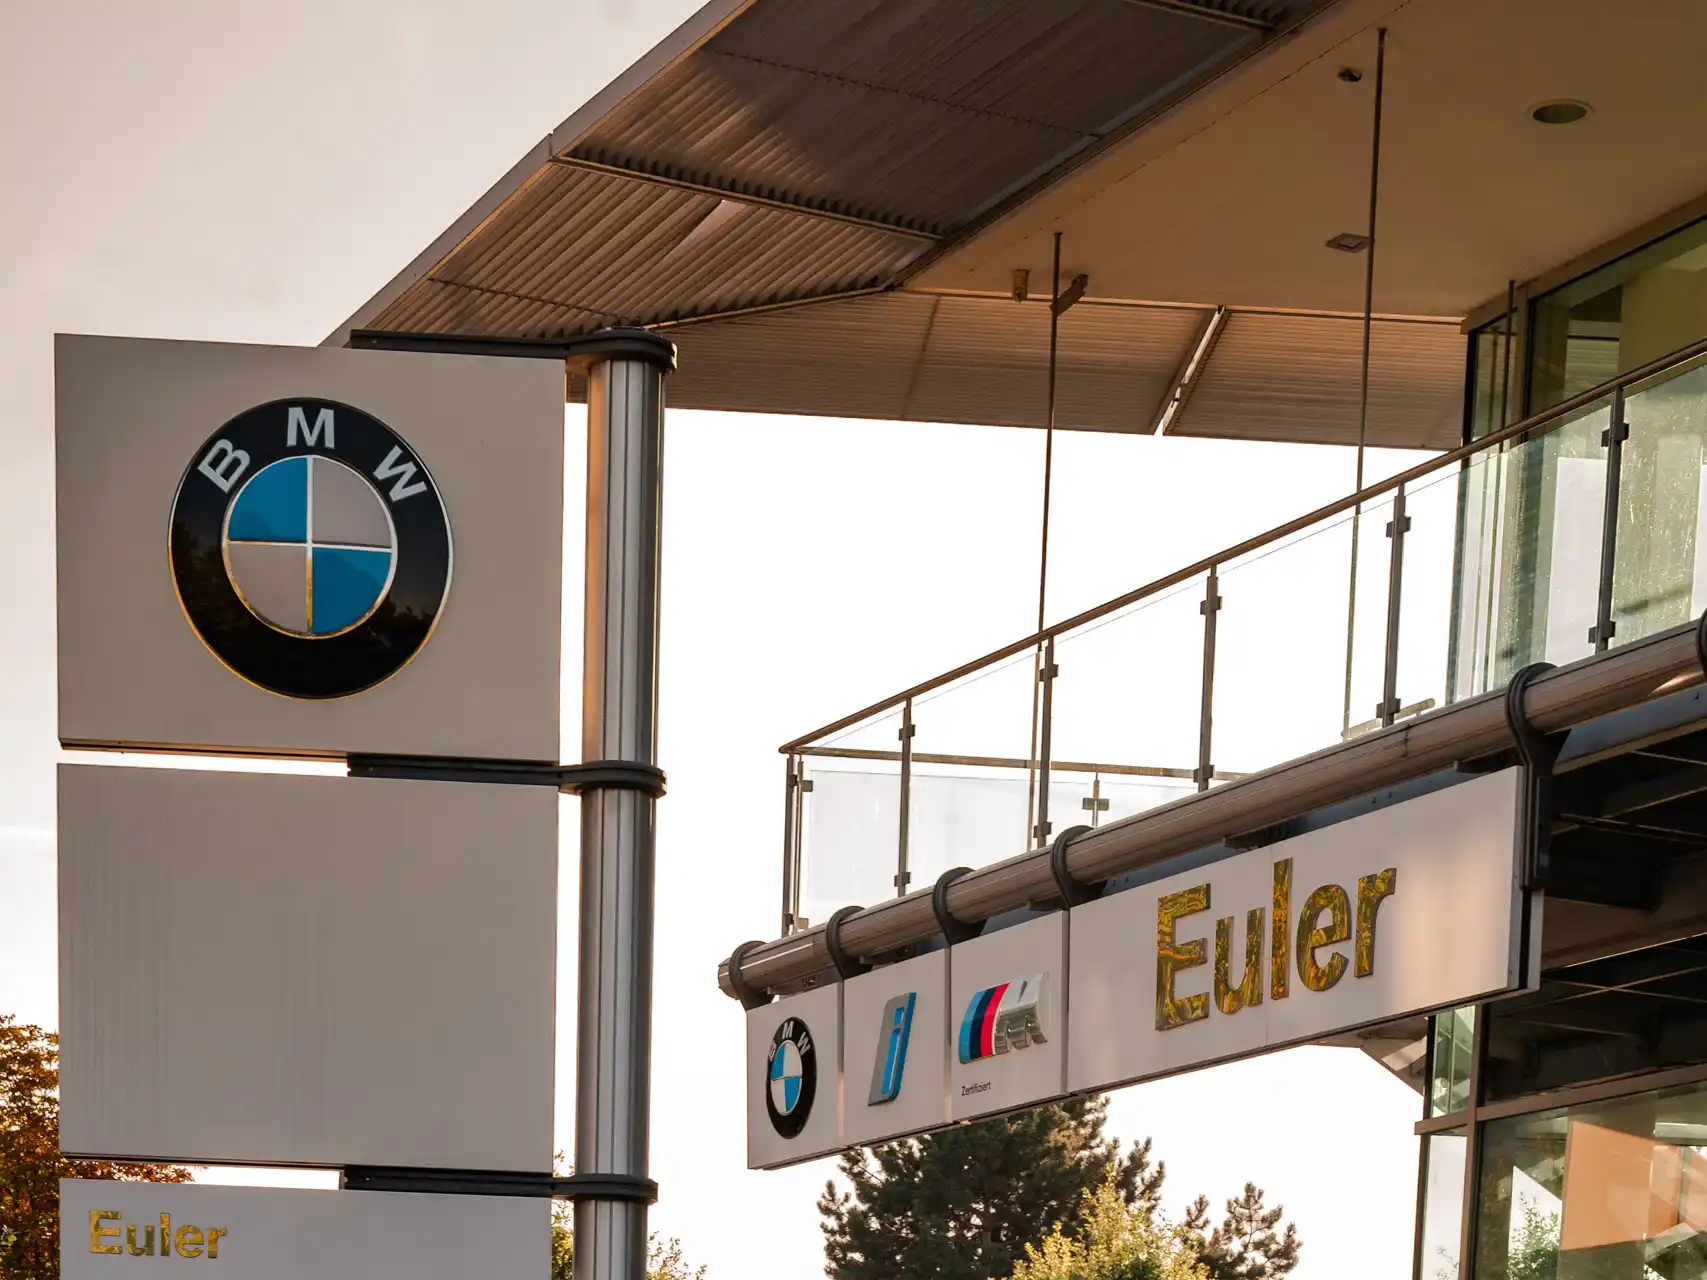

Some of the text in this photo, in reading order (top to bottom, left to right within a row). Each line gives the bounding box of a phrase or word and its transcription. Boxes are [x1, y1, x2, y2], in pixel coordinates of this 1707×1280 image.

[197, 406, 428, 503] BMW
[1155, 857, 1397, 1031] Euler
[768, 1020, 811, 1062] BMW
[89, 1209, 228, 1259] Euler
